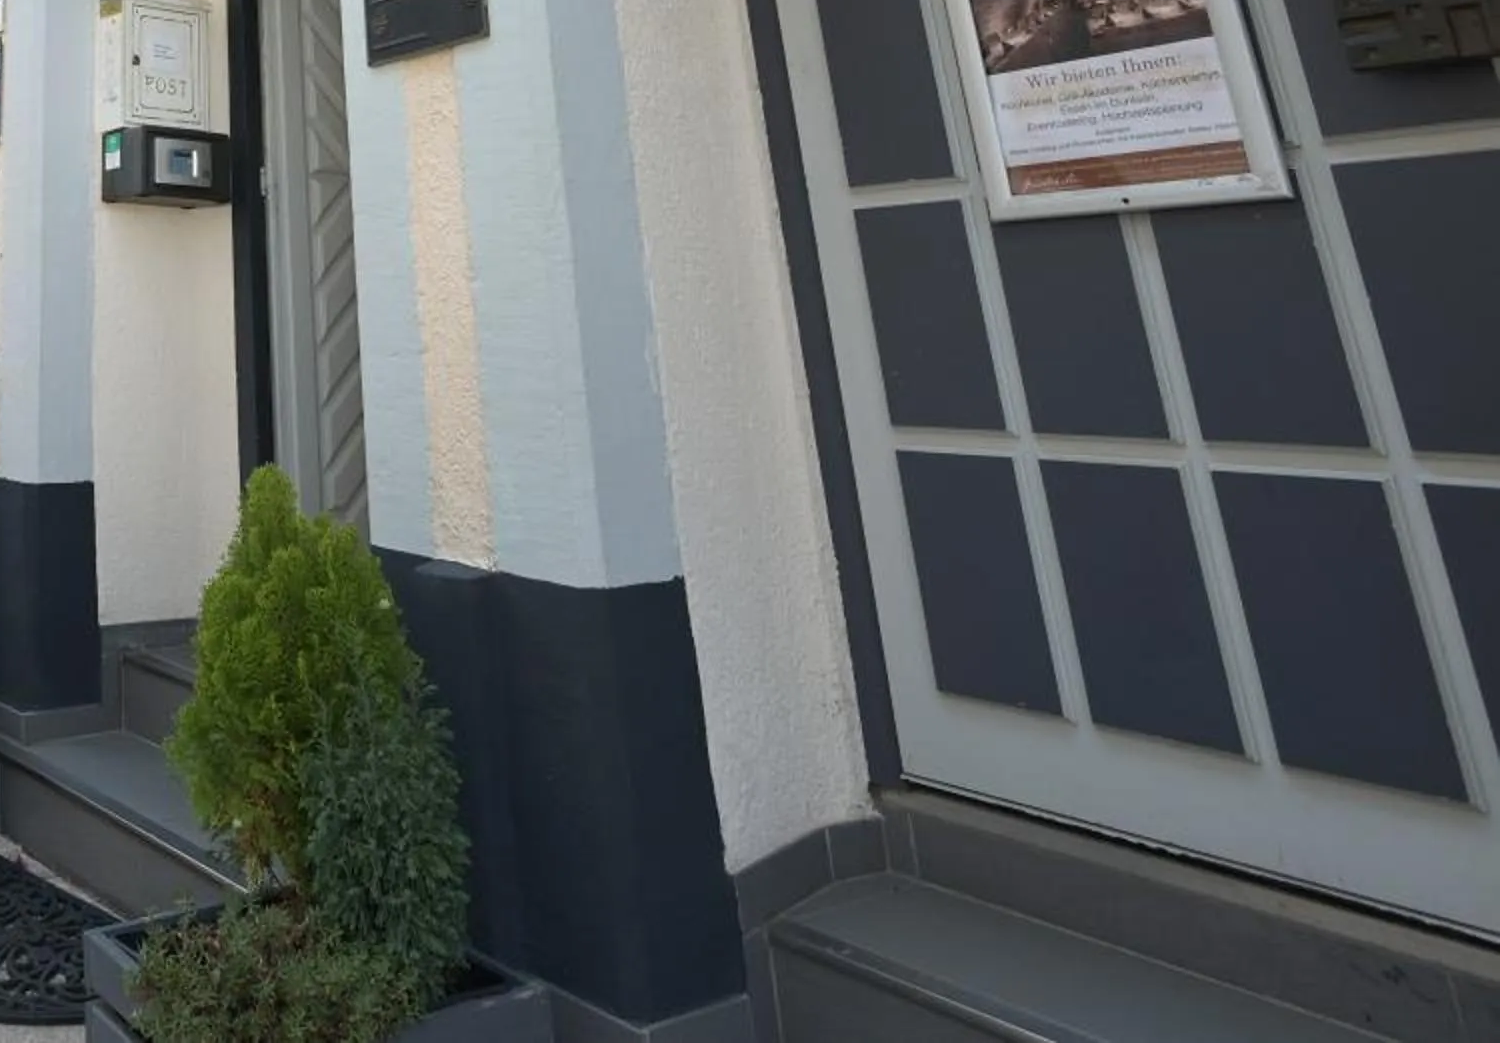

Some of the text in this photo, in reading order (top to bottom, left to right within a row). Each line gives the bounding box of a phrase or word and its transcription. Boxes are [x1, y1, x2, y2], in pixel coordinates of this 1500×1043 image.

[145, 75, 188, 99] POST
[1026, 73, 1057, 88] Wir
[1061, 63, 1117, 83] bieten
